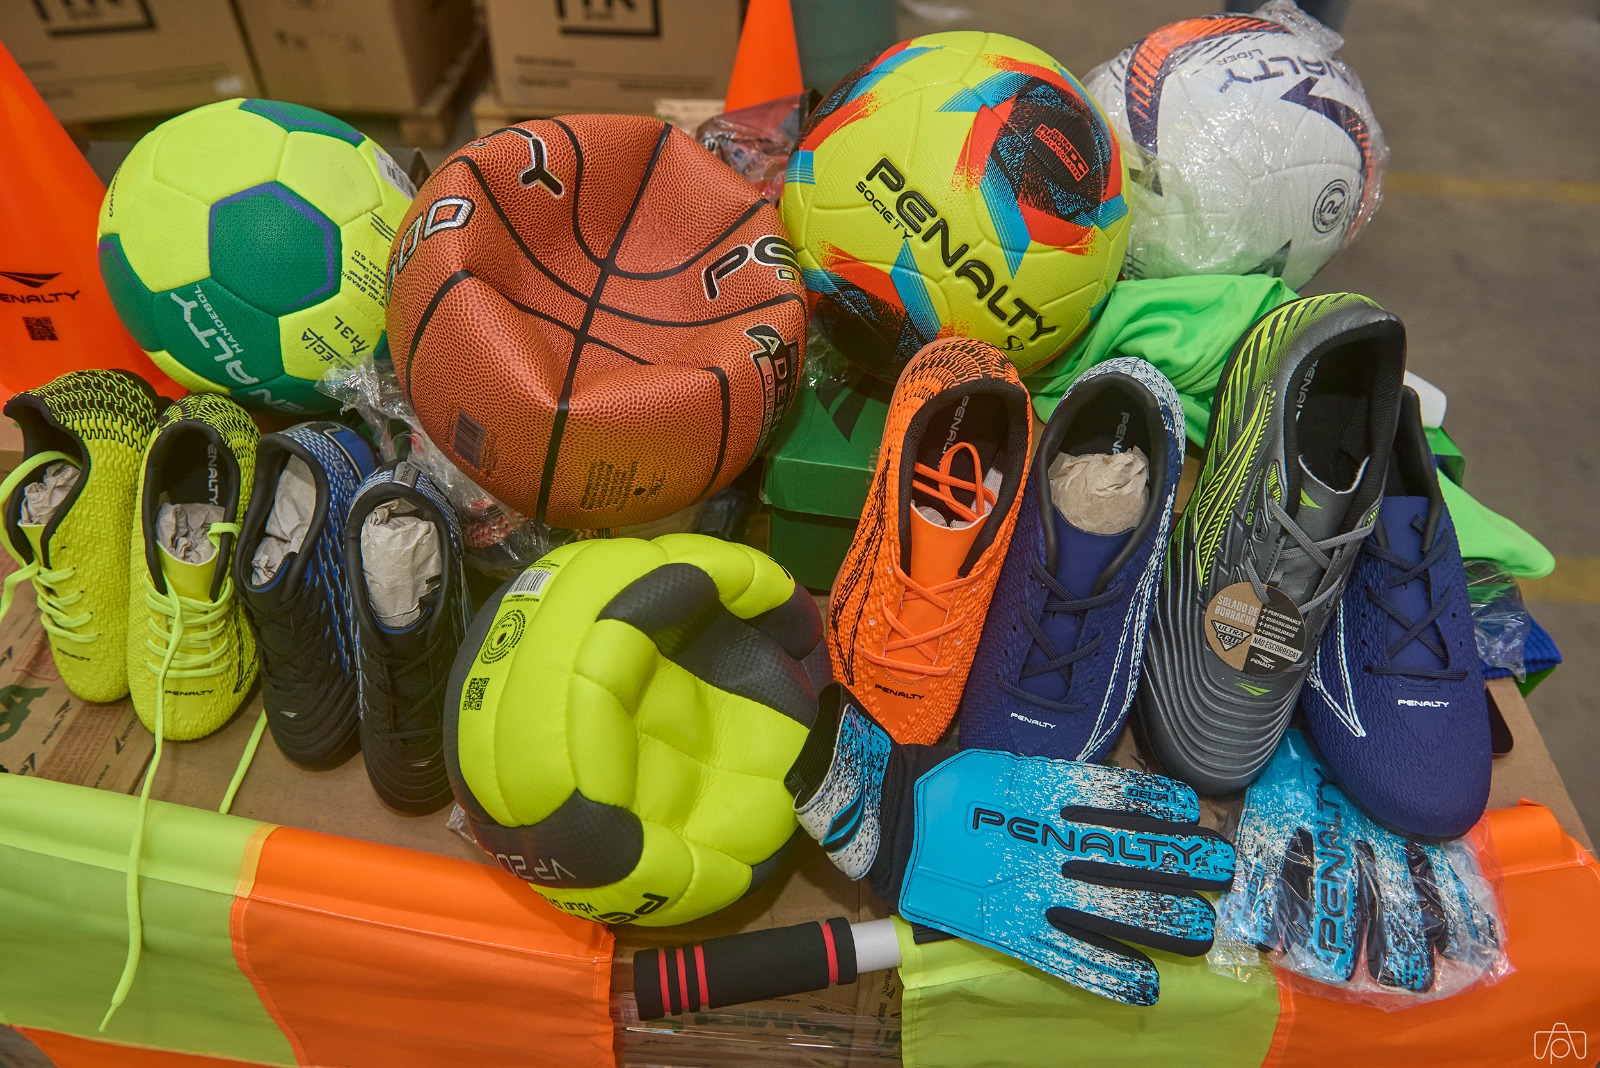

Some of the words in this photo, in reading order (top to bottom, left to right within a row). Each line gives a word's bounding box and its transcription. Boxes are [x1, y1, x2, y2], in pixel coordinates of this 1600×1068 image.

[1040, 125, 1070, 153] FUSION
[1052, 129, 1071, 148] ULTRA
[1035, 130, 1057, 151] DUPLA
[1058, 149, 1081, 180] COLAGEM
[855, 181, 913, 240] SOCIETY
[866, 157, 1056, 341] PENALTY
[0, 289, 80, 304] ENALTY
[194, 284, 244, 354] HANDEBOL
[942, 395, 970, 456] PENAL
[206, 442, 220, 505] ENALTY
[1217, 596, 1248, 613] SOLADO
[1248, 605, 1260, 617] DE
[1215, 607, 1257, 628] BORRACHA
[1217, 633, 1243, 645] GRIP
[1218, 624, 1244, 639] ULTRA
[1252, 636, 1265, 648] NÃO
[1265, 640, 1300, 660] ESCORREGA!
[1250, 658, 1276, 671] PENALTY
[164, 689, 215, 697] PENALTY
[874, 683, 925, 700] PENALTY
[1397, 699, 1450, 708] PENALTY
[1010, 711, 1056, 730] PENALTY
[1127, 787, 1169, 803] DELTA
[972, 807, 1203, 866] PENALTY
[1313, 768, 1348, 955] PENALTY
[1029, 935, 1060, 953] CRIADO
[1062, 949, 1079, 960] POR
[1080, 957, 1135, 980] BRASILEIROS
